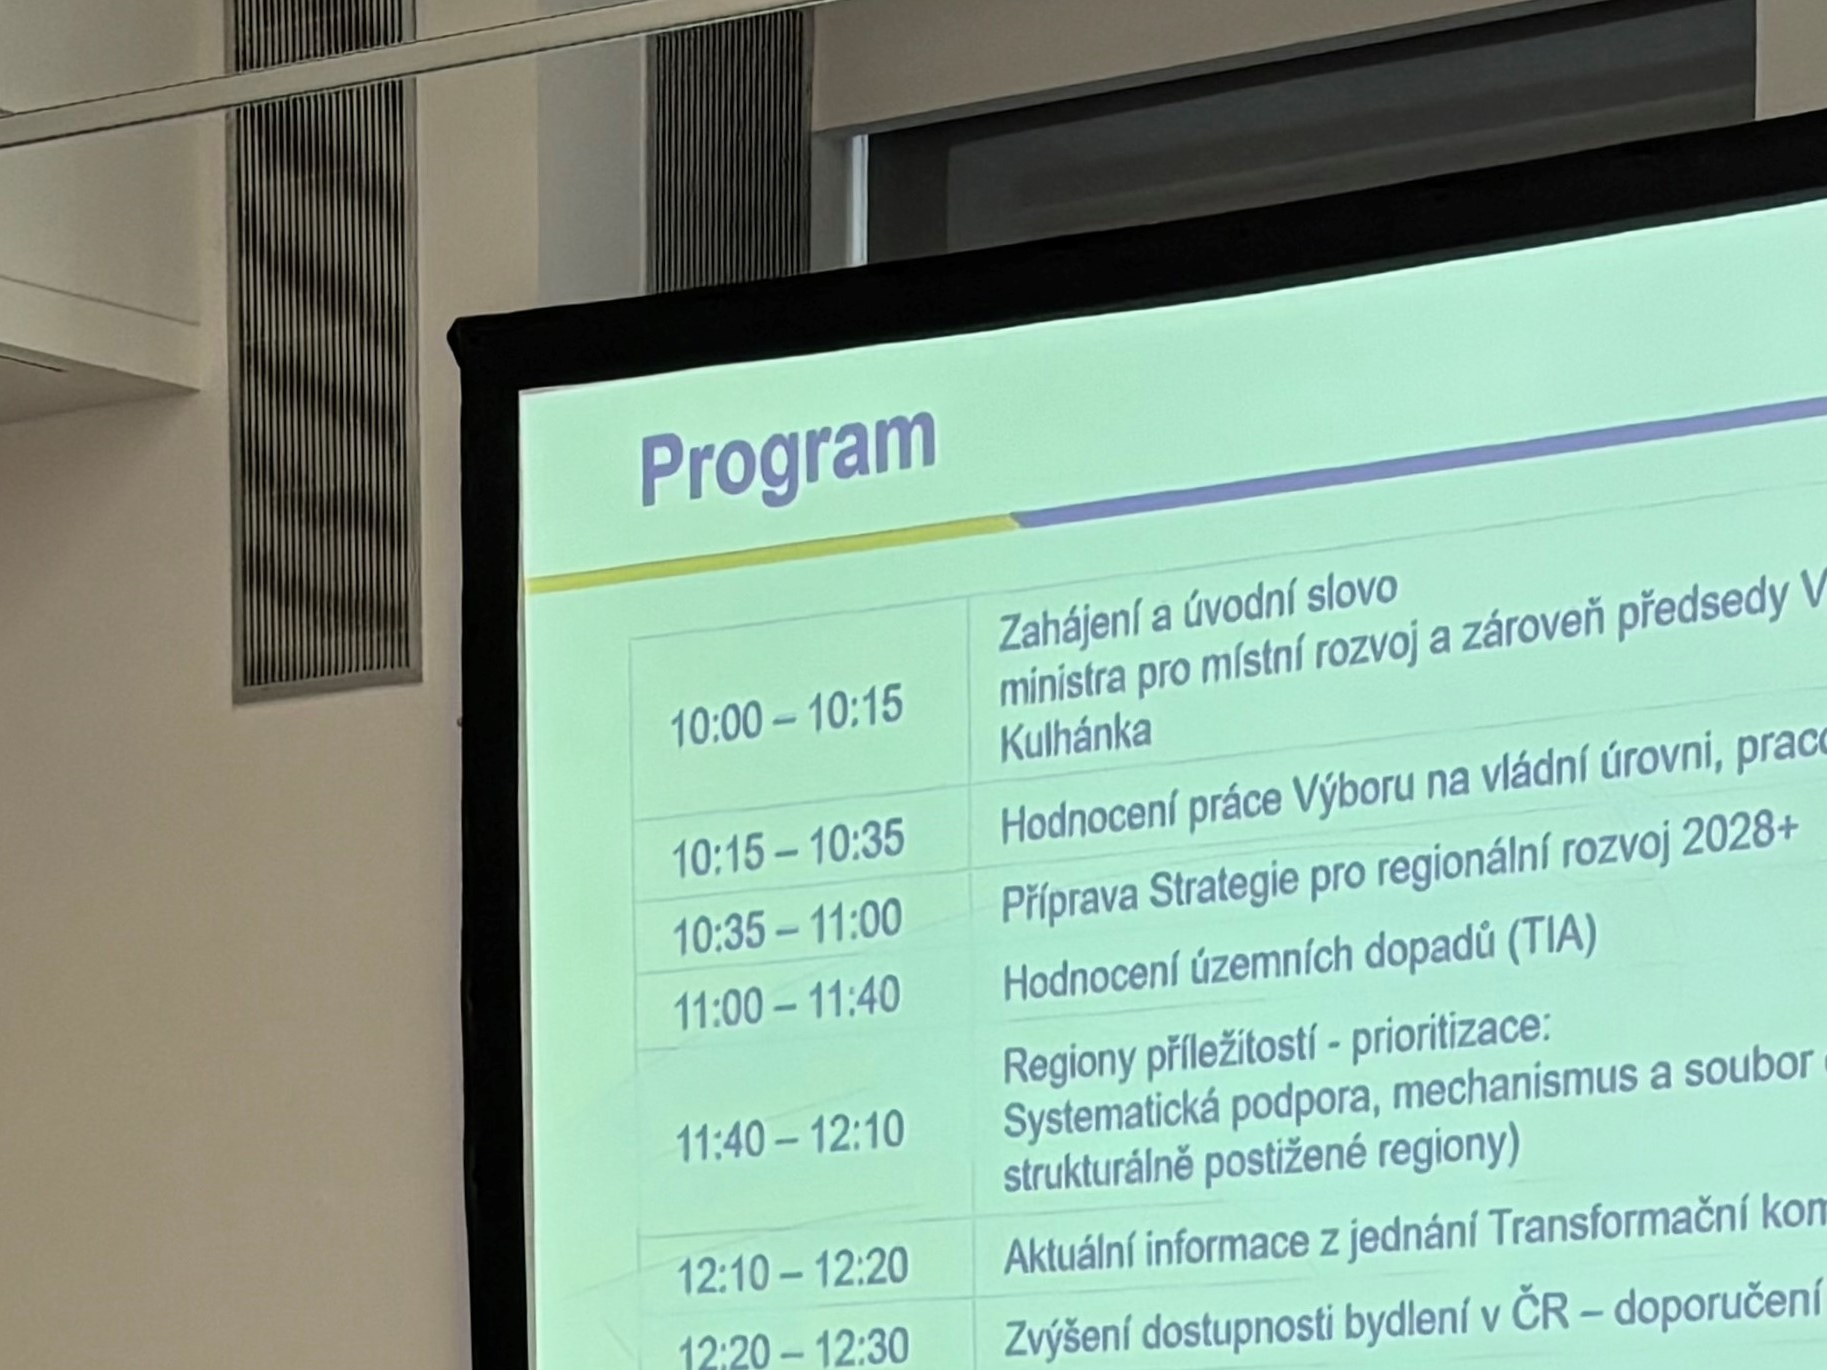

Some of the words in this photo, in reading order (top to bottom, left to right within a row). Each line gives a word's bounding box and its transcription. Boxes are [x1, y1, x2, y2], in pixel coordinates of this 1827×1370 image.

[641, 410, 936, 509] Program
[998, 596, 1144, 653] Zahájení
[1150, 603, 1173, 633] a
[1183, 575, 1299, 629] úvodní
[1306, 570, 1399, 614] slovo
[999, 660, 1127, 708] ministra
[1137, 656, 1192, 701] pro
[1201, 630, 1307, 685] místní
[1315, 617, 1419, 670] rozvoj
[1429, 624, 1451, 656] a
[1461, 594, 1606, 653] zároveň
[1617, 573, 1791, 644] předsedy
[670, 699, 764, 749] 10:00
[807, 681, 904, 734] 10:15
[1000, 710, 1153, 764] Kulhánka
[1001, 787, 1180, 846] Hodnocení
[1188, 780, 1283, 836] práce
[1291, 769, 1415, 822] Výboru
[1427, 766, 1471, 800] na
[1480, 742, 1591, 794] vládní
[1600, 729, 1723, 781] úrovni,
[672, 830, 766, 879] 10:15
[809, 815, 906, 866] 10:35
[1001, 880, 1139, 929] Příprava
[1149, 858, 1300, 910] Strategie
[1309, 859, 1367, 904] pro
[1377, 830, 1553, 893] regionální
[1562, 818, 1671, 870] rozvoj
[1681, 807, 1800, 857] 2028+
[673, 909, 767, 958] 10:35
[809, 896, 903, 945] 11:00
[1003, 948, 1181, 1003] Hodnocení
[1190, 933, 1353, 986] územních
[1364, 918, 1496, 977] dopadů
[1507, 911, 1598, 967] (TIA)
[673, 985, 764, 1032] 11:00
[808, 973, 901, 1020] 11:40
[1003, 1041, 1138, 1091] Regiony
[1146, 1021, 1319, 1084] příležitostí
[1351, 1010, 1552, 1068] prioritizace:
[676, 1118, 766, 1164] 11:40
[810, 1107, 905, 1155] 12:10
[1002, 1085, 1221, 1148] Systematická
[1231, 1080, 1381, 1133] podpora,
[1392, 1059, 1639, 1111] mechanismus
[1650, 1059, 1673, 1091] a
[1683, 1043, 1816, 1088] soubor
[1003, 1143, 1195, 1193] strukturálně
[1204, 1130, 1368, 1190] postižené
[1377, 1120, 1520, 1176] regiony)
[677, 1252, 770, 1296] 12:10
[814, 1245, 910, 1289] 12:20
[1002, 1229, 1138, 1276] Aktuální
[1145, 1226, 1310, 1268] informace
[1318, 1227, 1341, 1258] z
[1346, 1208, 1480, 1266] jednání
[1487, 1192, 1751, 1247] Transformační
[815, 1325, 910, 1369] 12:30
[1003, 1312, 1133, 1365] Zvýšení
[1141, 1302, 1334, 1356] dostupnosti
[1344, 1295, 1472, 1349] bydlení
[1479, 1304, 1502, 1334] v
[1511, 1282, 1571, 1331] ČR
[1613, 1275, 1825, 1335] doporučení
